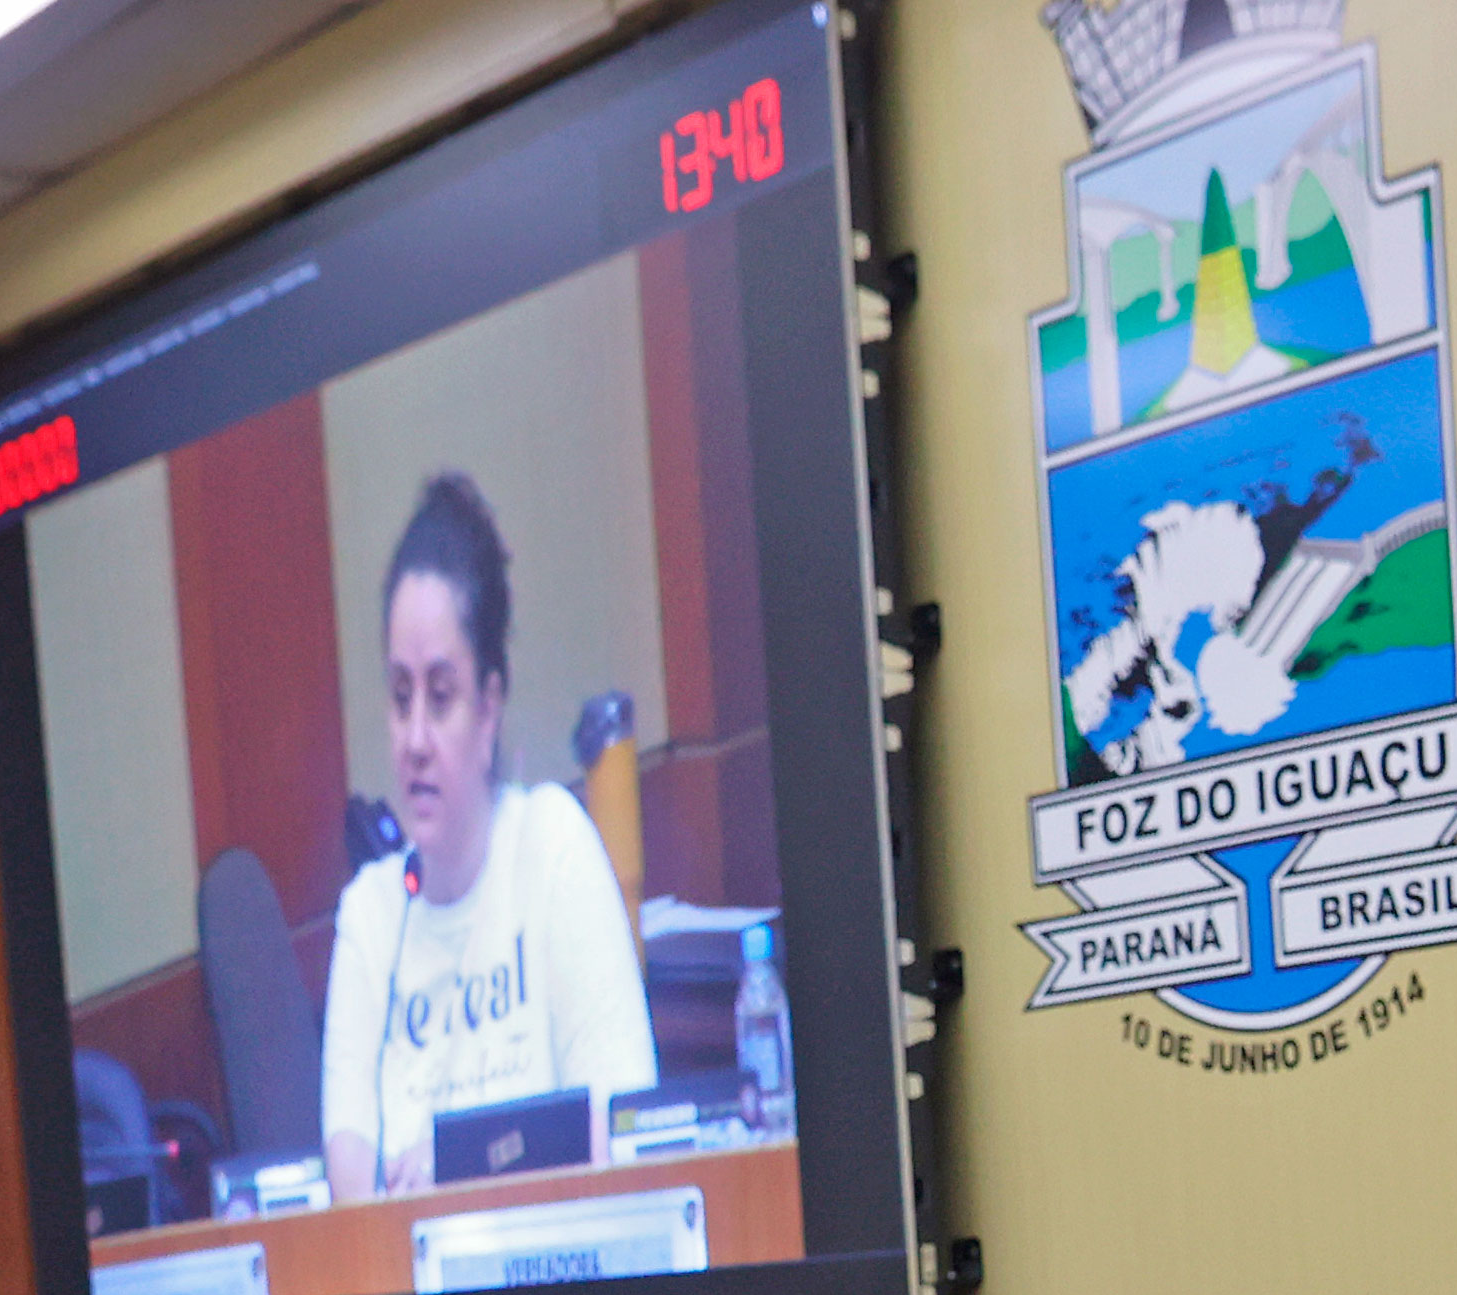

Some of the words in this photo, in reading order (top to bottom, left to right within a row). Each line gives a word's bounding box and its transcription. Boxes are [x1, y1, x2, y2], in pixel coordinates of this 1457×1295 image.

[1076, 796, 1158, 849] FOZ
[1177, 780, 1236, 829] DO
[1256, 733, 1446, 813] IGUAÇU
[1079, 908, 1222, 972] PARANÁ
[1121, 1013, 1151, 1049] 10
[1157, 1028, 1191, 1065] DE
[1200, 1037, 1300, 1073] JUNHO
[1309, 1018, 1348, 1059] DE
[1356, 972, 1426, 1040] 1914
